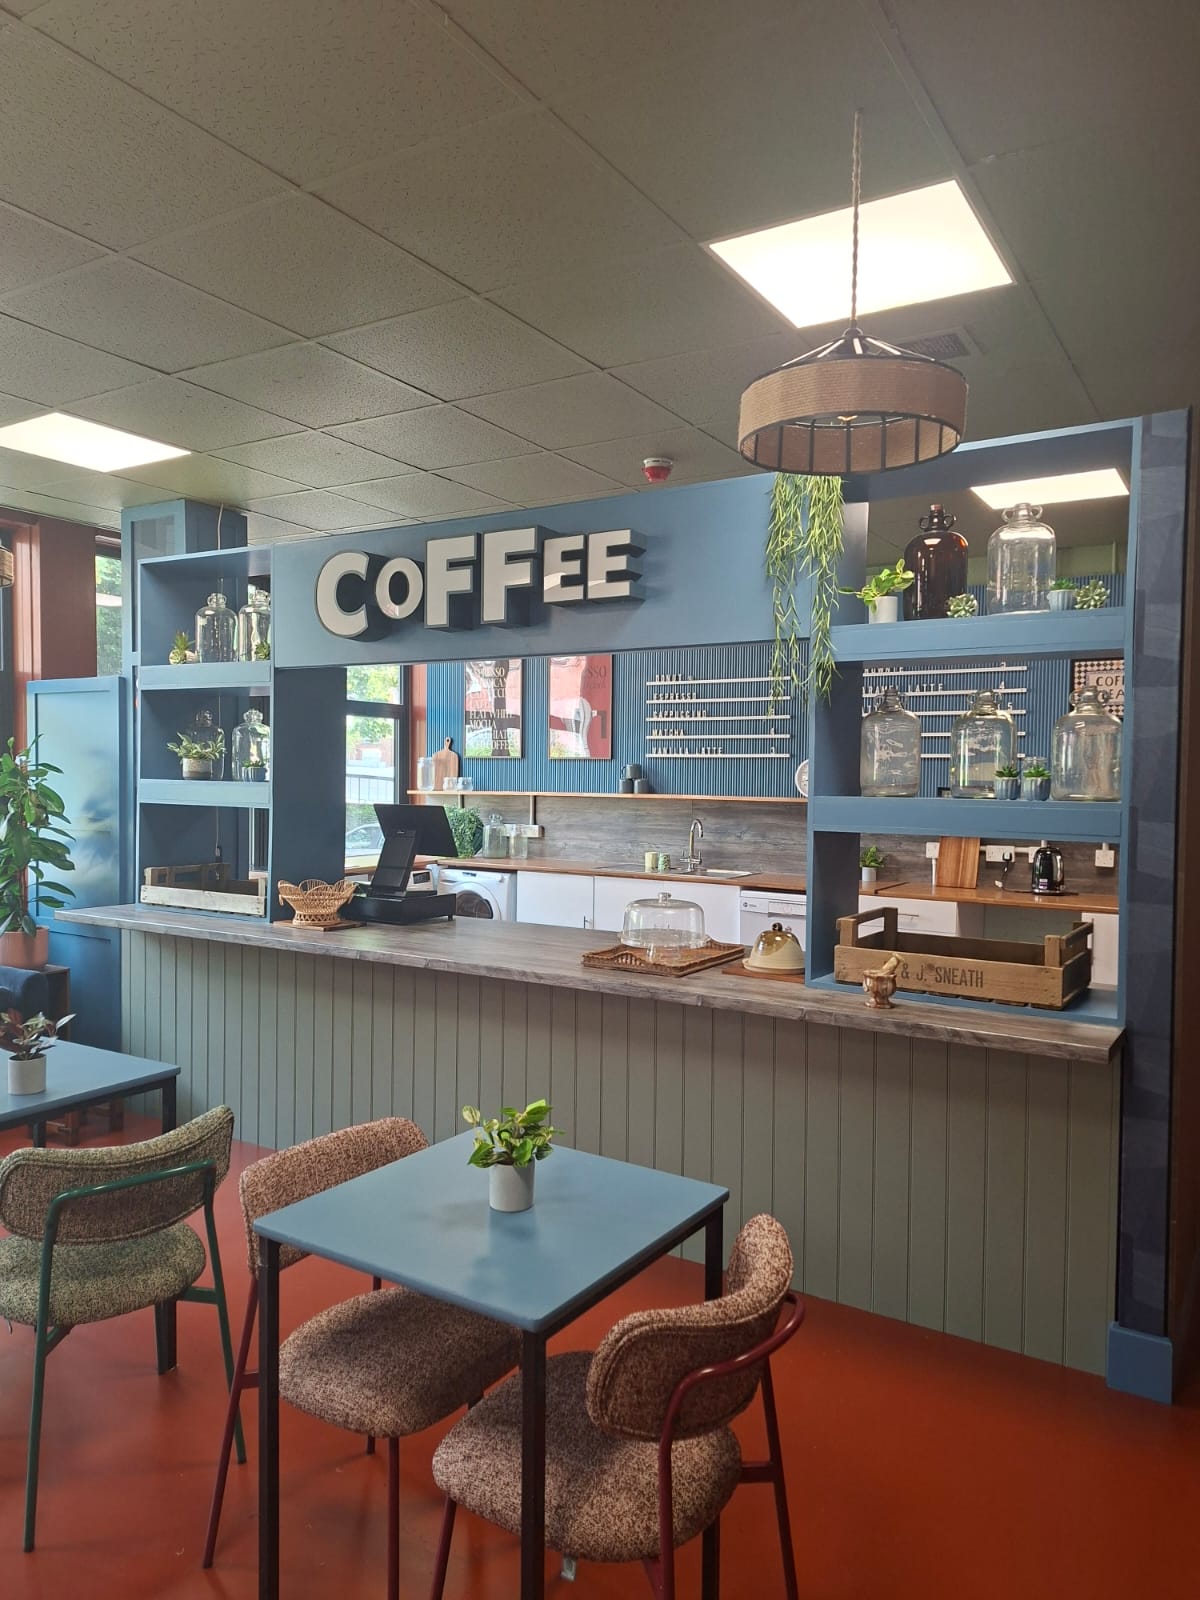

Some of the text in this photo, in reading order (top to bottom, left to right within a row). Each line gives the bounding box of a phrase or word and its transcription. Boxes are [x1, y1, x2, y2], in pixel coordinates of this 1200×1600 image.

[316, 527, 632, 638] COFFEE
[1096, 676, 1125, 687] COF
[908, 683, 944, 692] LATTE
[653, 692, 697, 701] ESPRESSO
[469, 719, 497, 729] MOCHA
[652, 728, 684, 737] MATCHA
[652, 746, 689, 755] VANILLA
[696, 746, 723, 755] LATTE
[935, 966, 984, 989] SNEATH
